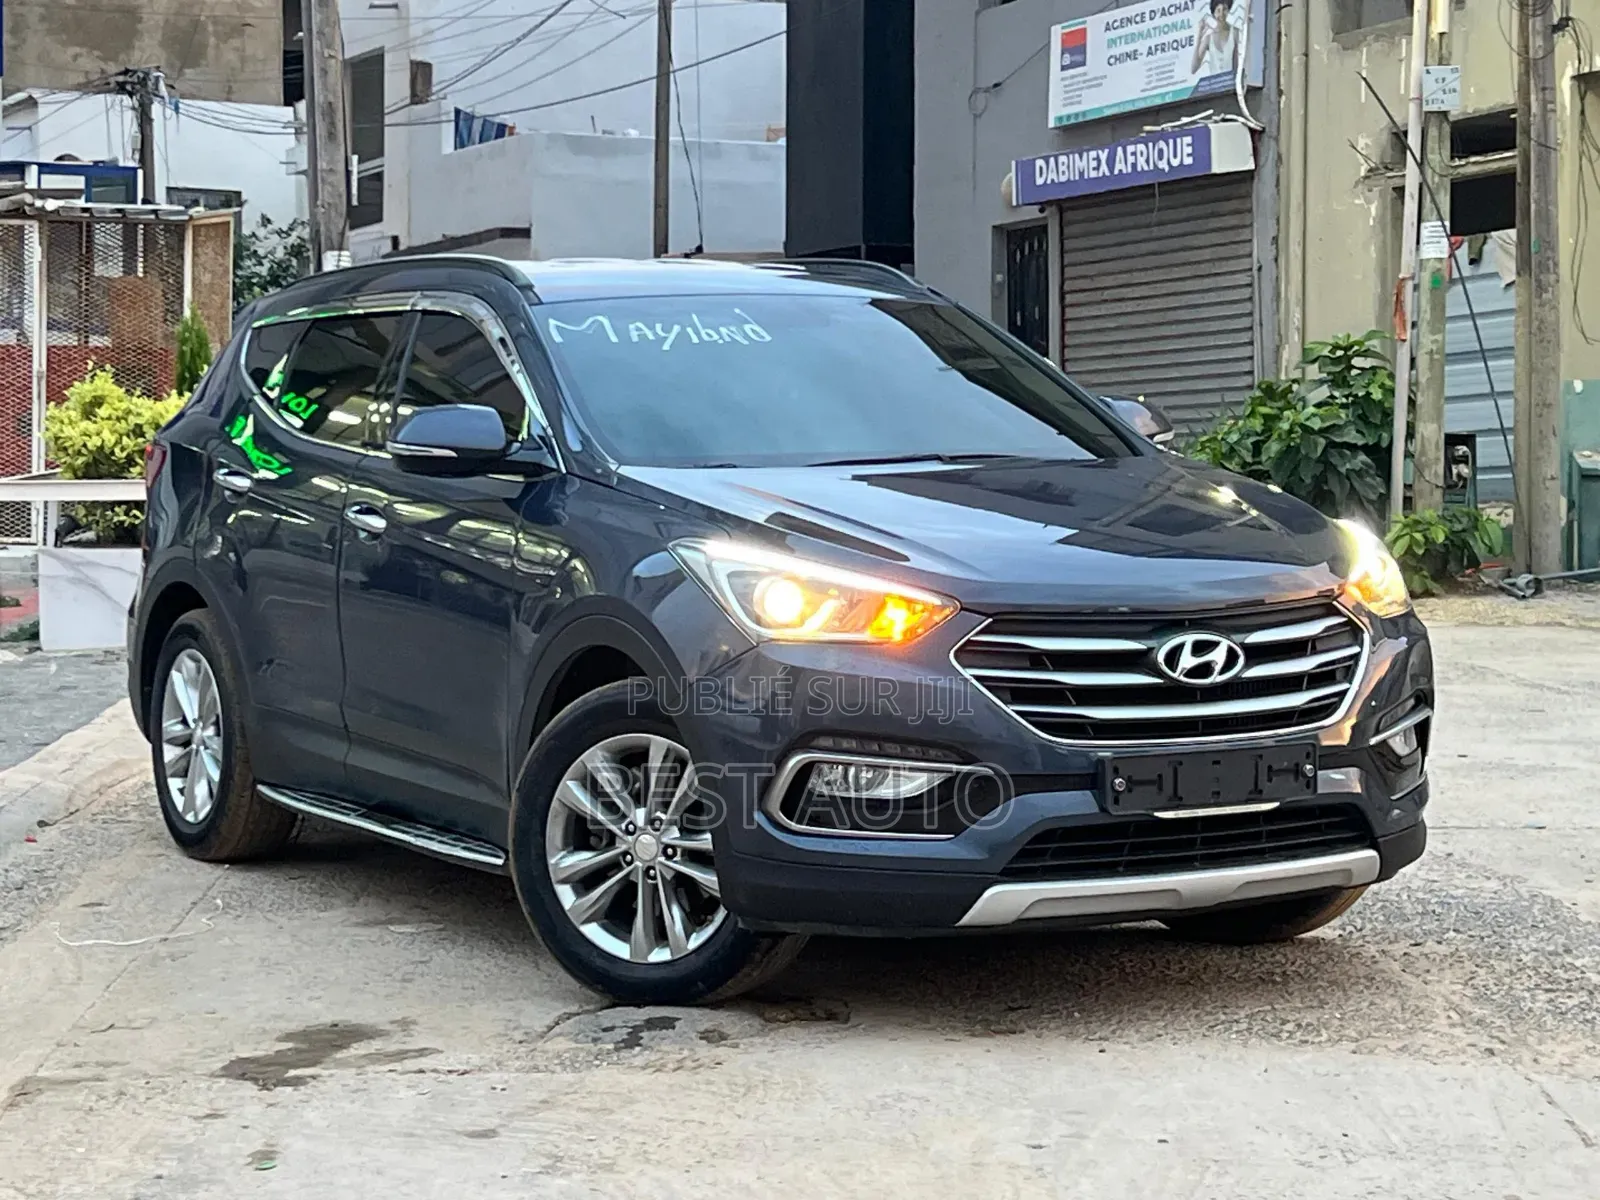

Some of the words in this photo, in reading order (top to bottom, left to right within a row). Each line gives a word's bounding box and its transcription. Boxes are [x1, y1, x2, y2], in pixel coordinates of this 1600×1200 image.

[1104, 15, 1147, 33] AGENCE
[1149, 0, 1196, 22] D'ACHAT
[1107, 18, 1194, 49] INTERNATIONAL
[1146, 35, 1195, 57] AFRIQUE
[1035, 149, 1109, 186] DABIMEX
[1114, 135, 1194, 175] AFRIQUE
